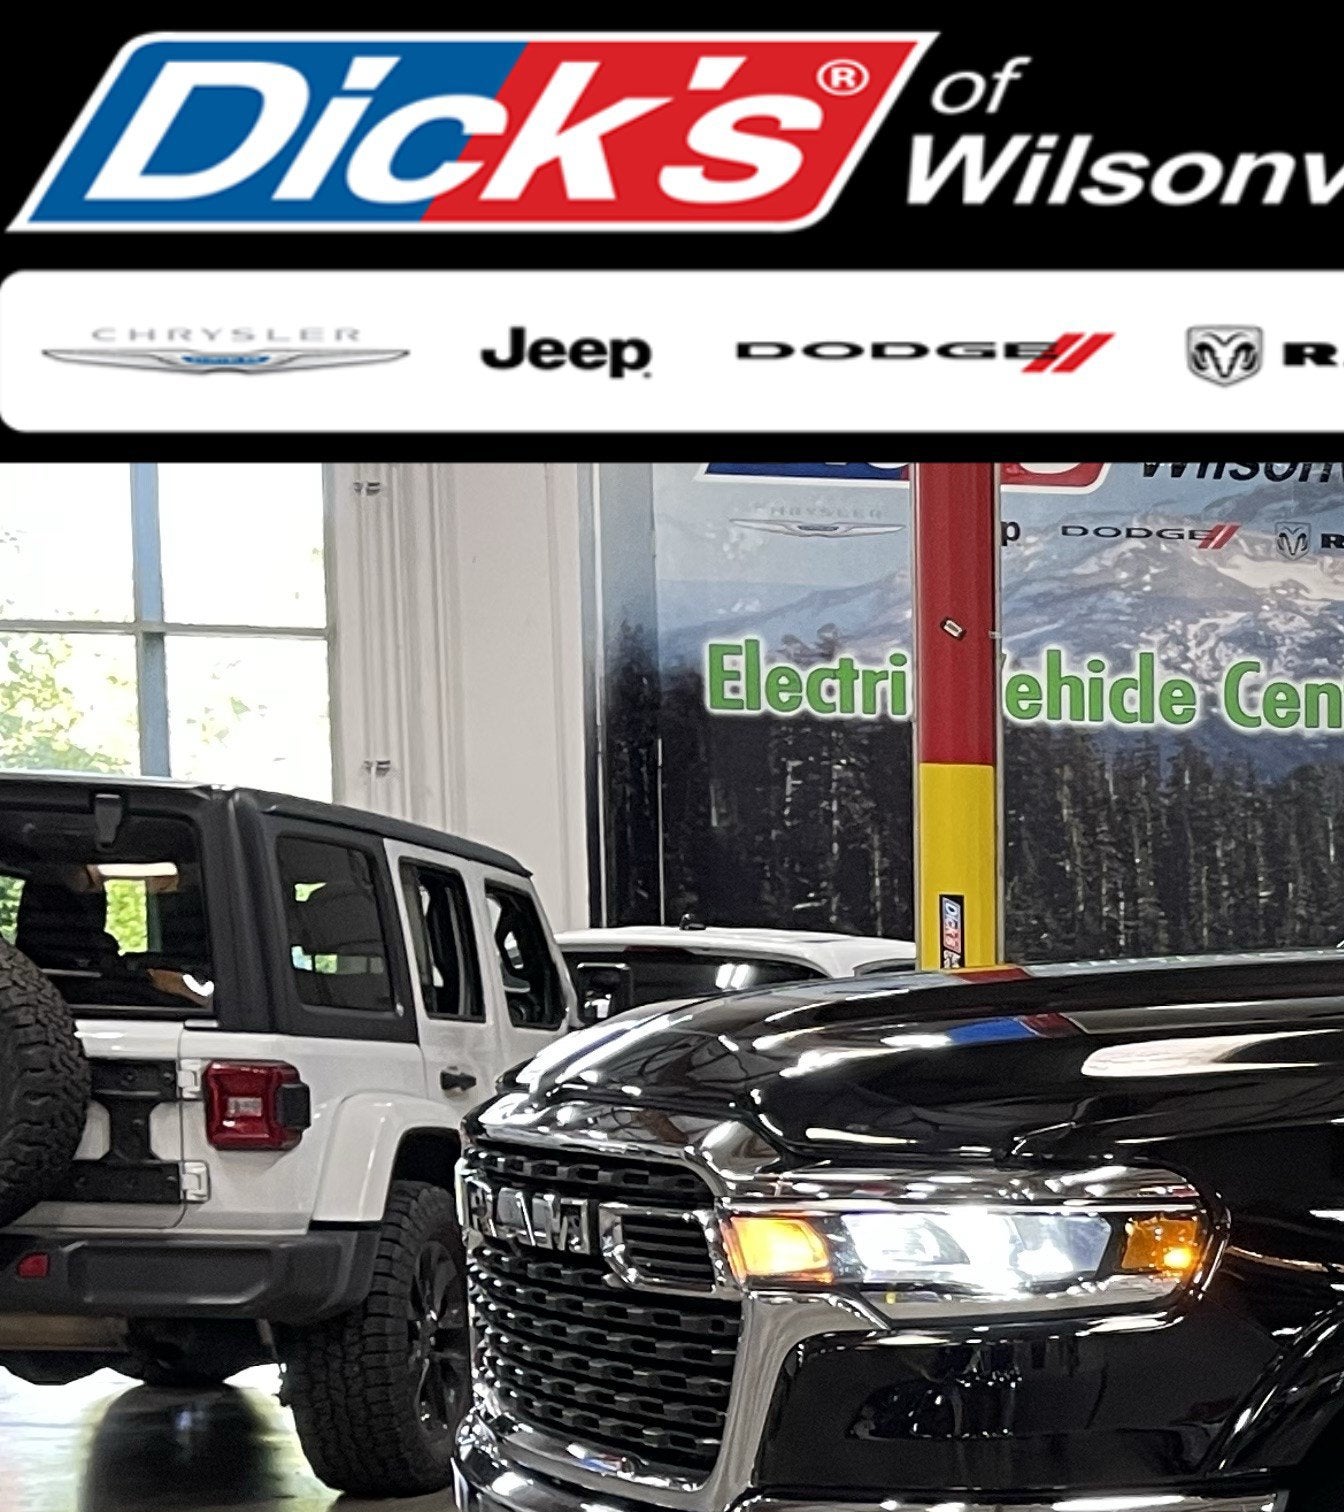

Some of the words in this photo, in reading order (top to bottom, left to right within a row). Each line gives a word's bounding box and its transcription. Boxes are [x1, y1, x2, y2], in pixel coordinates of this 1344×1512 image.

[1061, 525, 1214, 541] DODGE
[708, 638, 908, 716] Electri
[1000, 649, 1197, 726] ehicle
